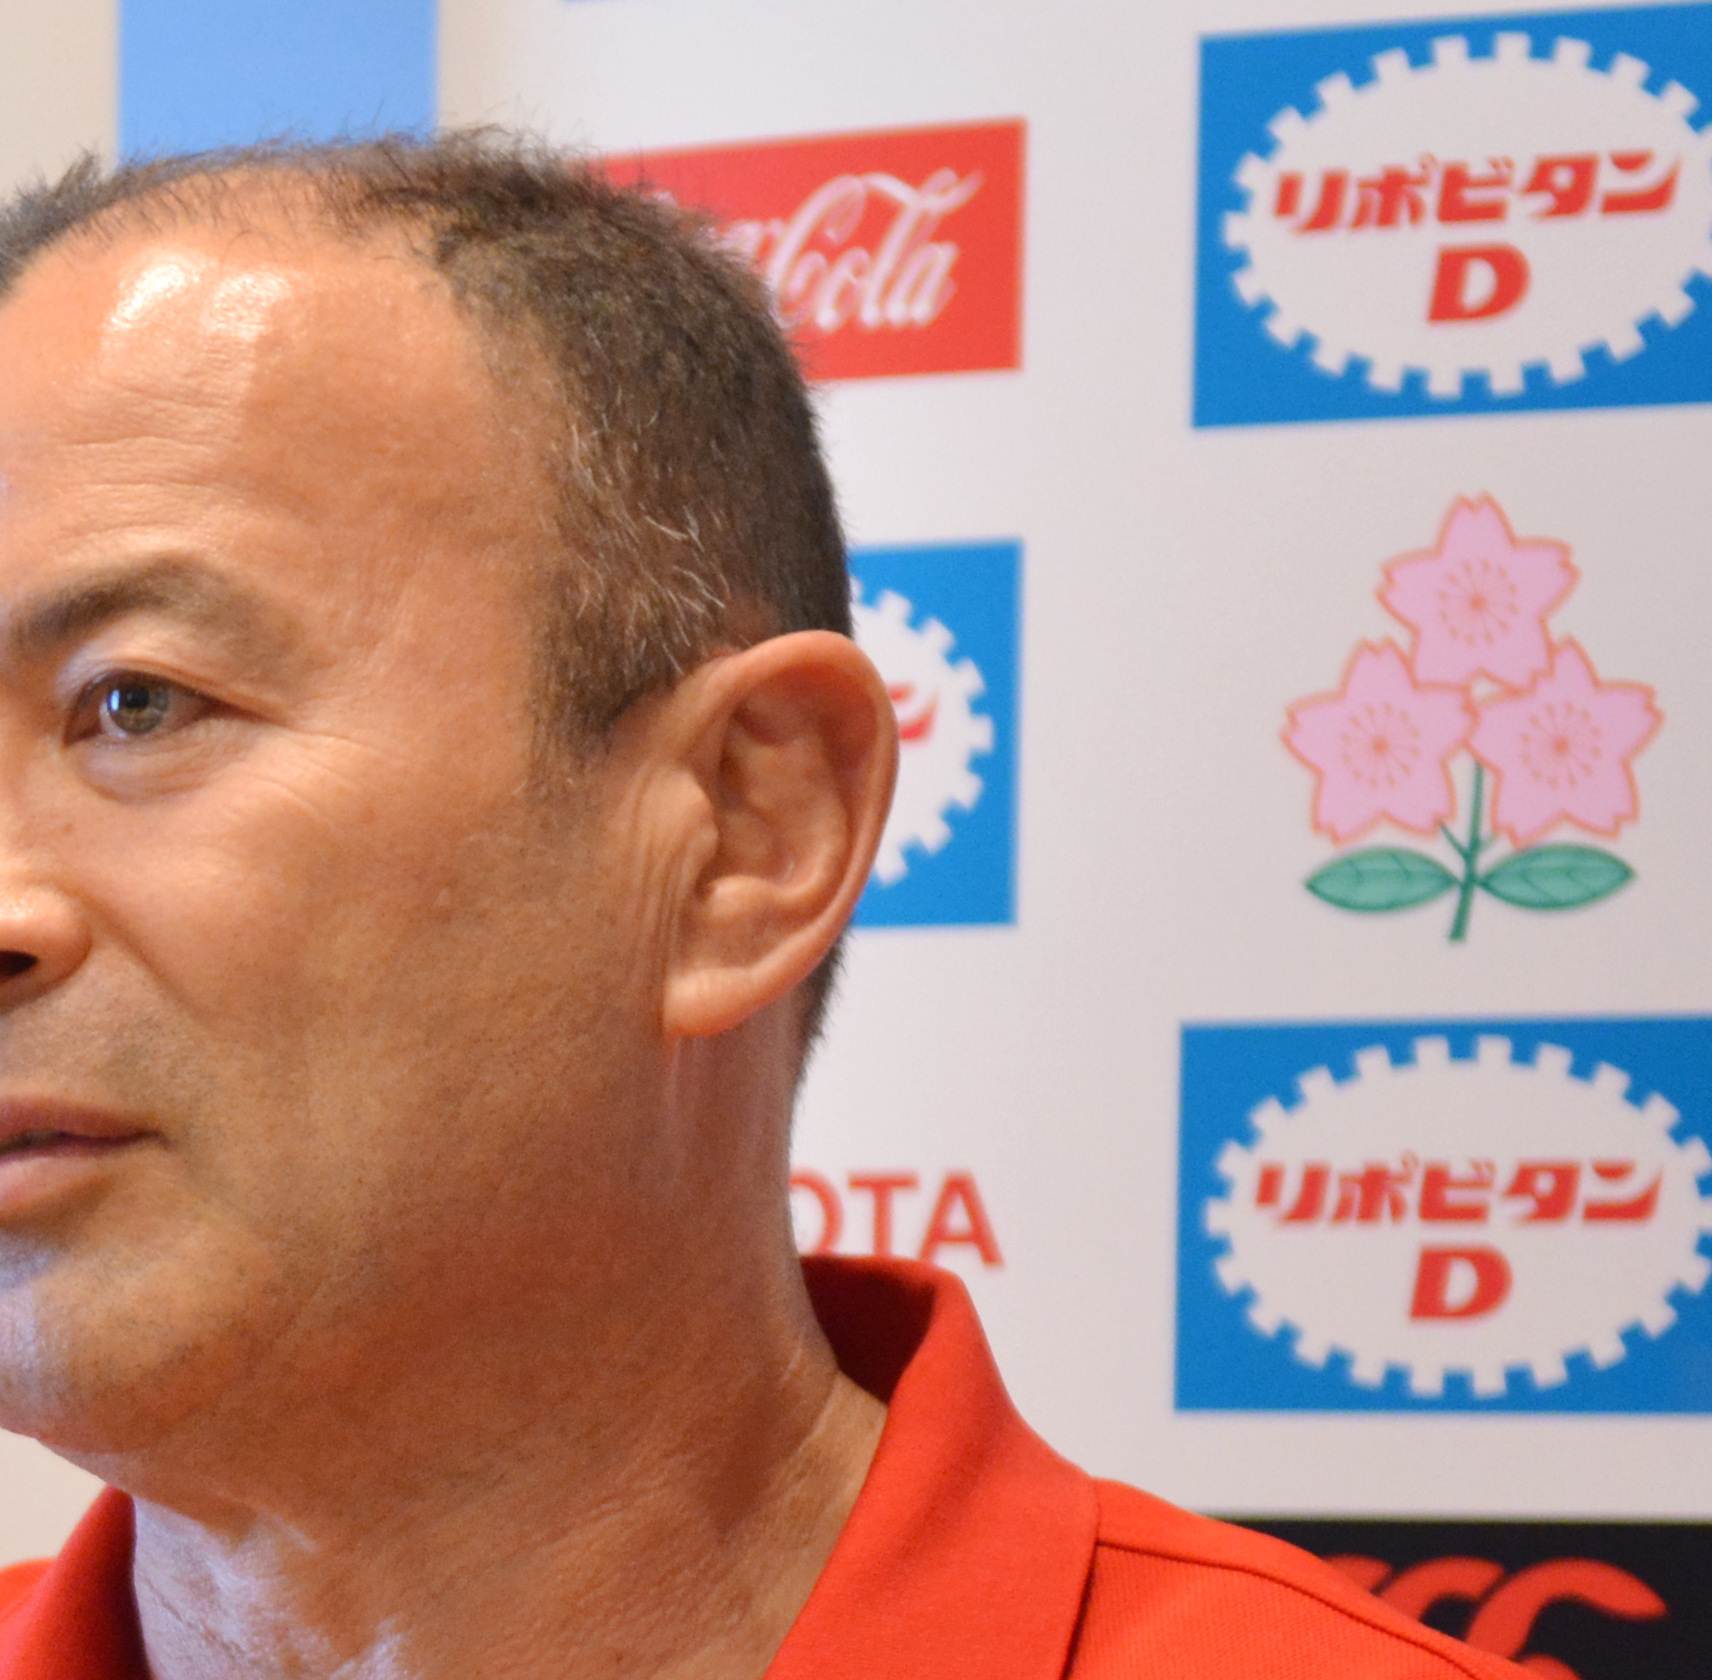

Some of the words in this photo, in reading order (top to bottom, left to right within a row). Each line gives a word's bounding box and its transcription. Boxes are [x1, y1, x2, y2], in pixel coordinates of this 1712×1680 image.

[1273, 150, 1680, 234] リポビタン
[1426, 244, 1531, 324] D
[1256, 1155, 1663, 1226] リポビタン
[1408, 1244, 1514, 1322] D
